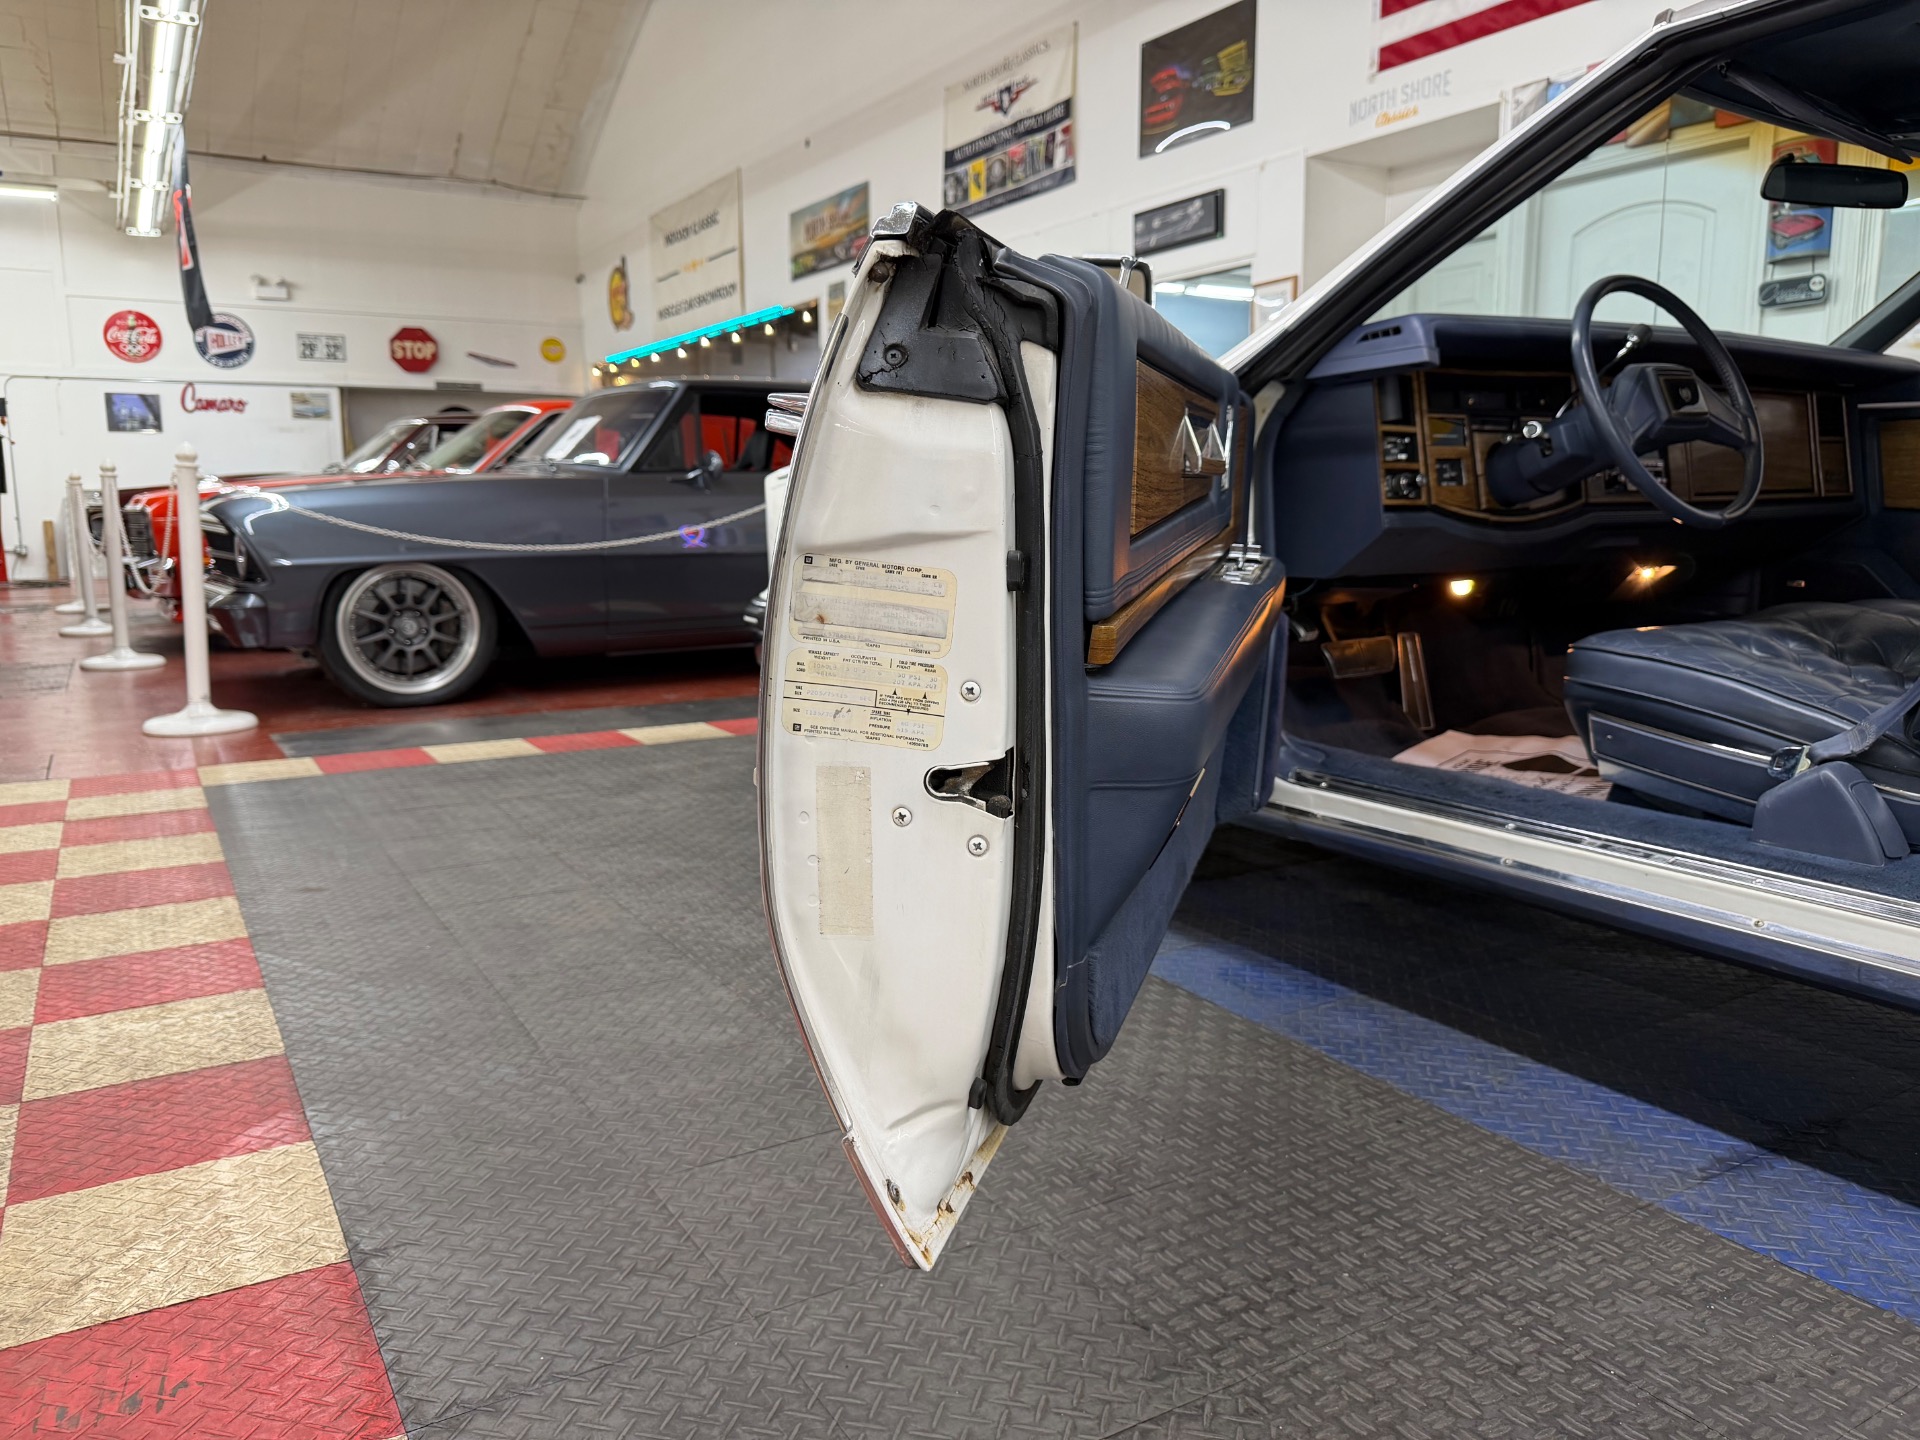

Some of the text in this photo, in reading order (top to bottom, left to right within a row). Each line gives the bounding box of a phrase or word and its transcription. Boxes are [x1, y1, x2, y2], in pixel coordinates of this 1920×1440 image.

[1349, 69, 1452, 127] NORTH SHORE
[392, 340, 435, 361] STOP
[180, 383, 248, 413] Camaro
[854, 560, 880, 569] GENERAL
[881, 564, 905, 572] MOTORS
[870, 731, 894, 739] ADDITIONAL
[895, 735, 925, 743] INFORMATION
